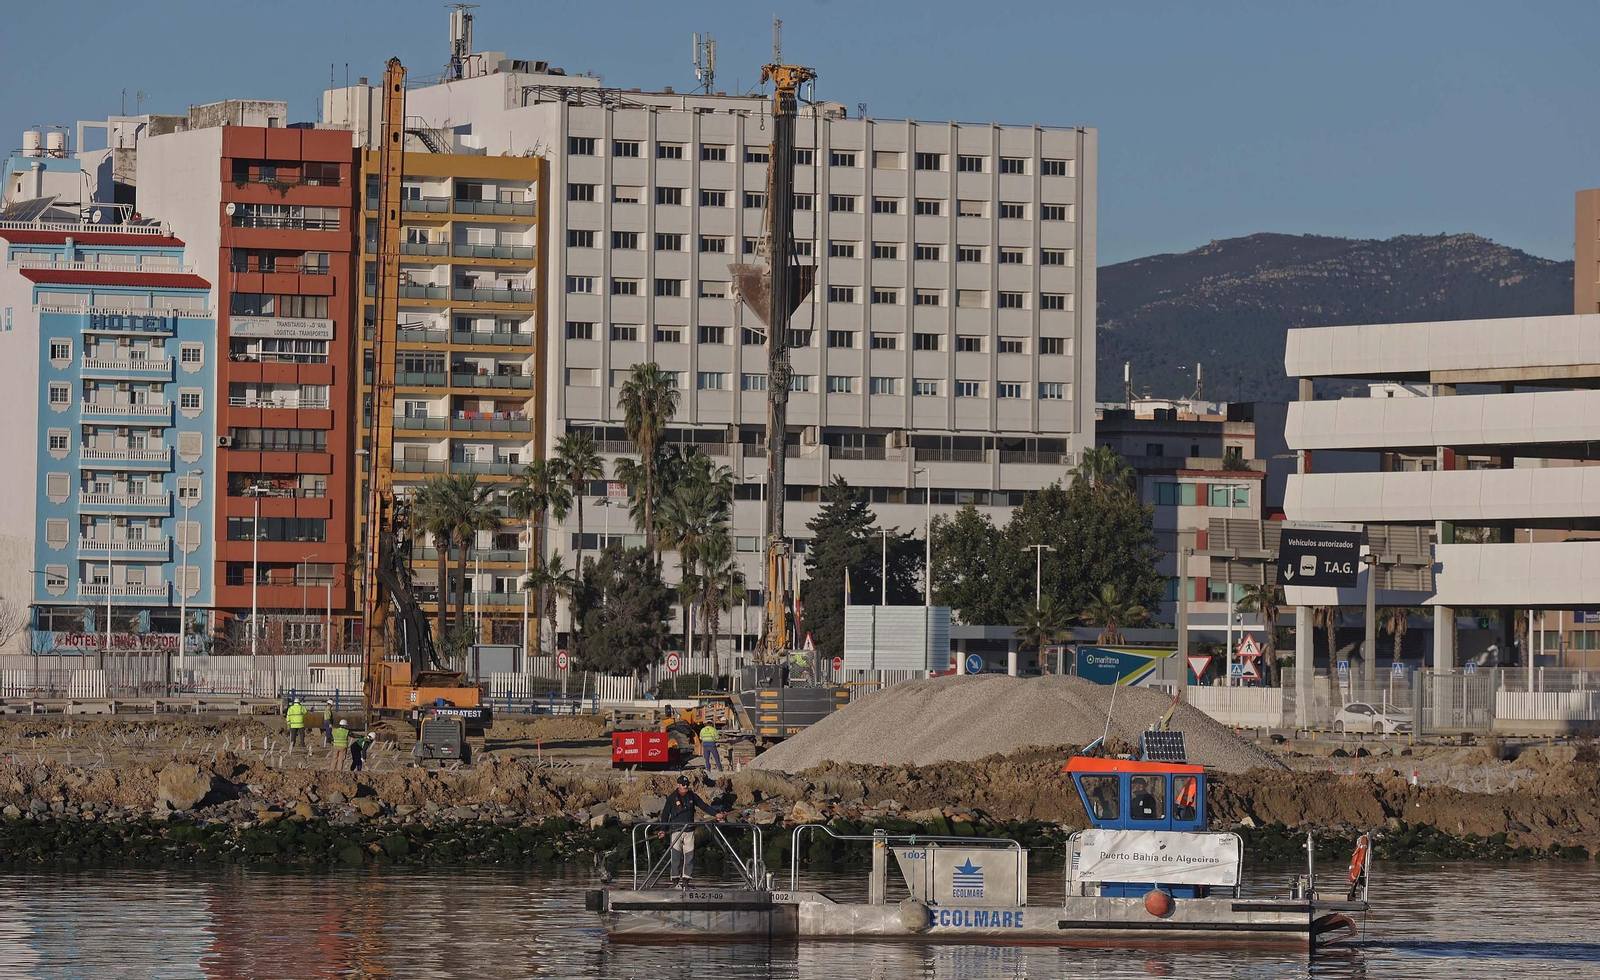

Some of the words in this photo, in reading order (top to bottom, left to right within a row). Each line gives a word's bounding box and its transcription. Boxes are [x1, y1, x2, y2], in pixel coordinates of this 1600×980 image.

[90, 314, 173, 332] HOTEL
[1288, 539, 1317, 547] Vehículos
[1318, 540, 1353, 549] autorizados
[1324, 561, 1353, 574] T.A.G.
[65, 635, 96, 646] HOTEL
[669, 659, 678, 667] 20
[436, 709, 482, 718] TERRATEST
[1100, 851, 1130, 861] Puerto
[1133, 852, 1159, 862] Bahía
[1161, 853, 1174, 862] de
[1176, 855, 1220, 865] Algeciras
[771, 893, 789, 901] 1002
[953, 889, 984, 898] ECOLMARE
[930, 909, 1024, 928] ECOLMARE
